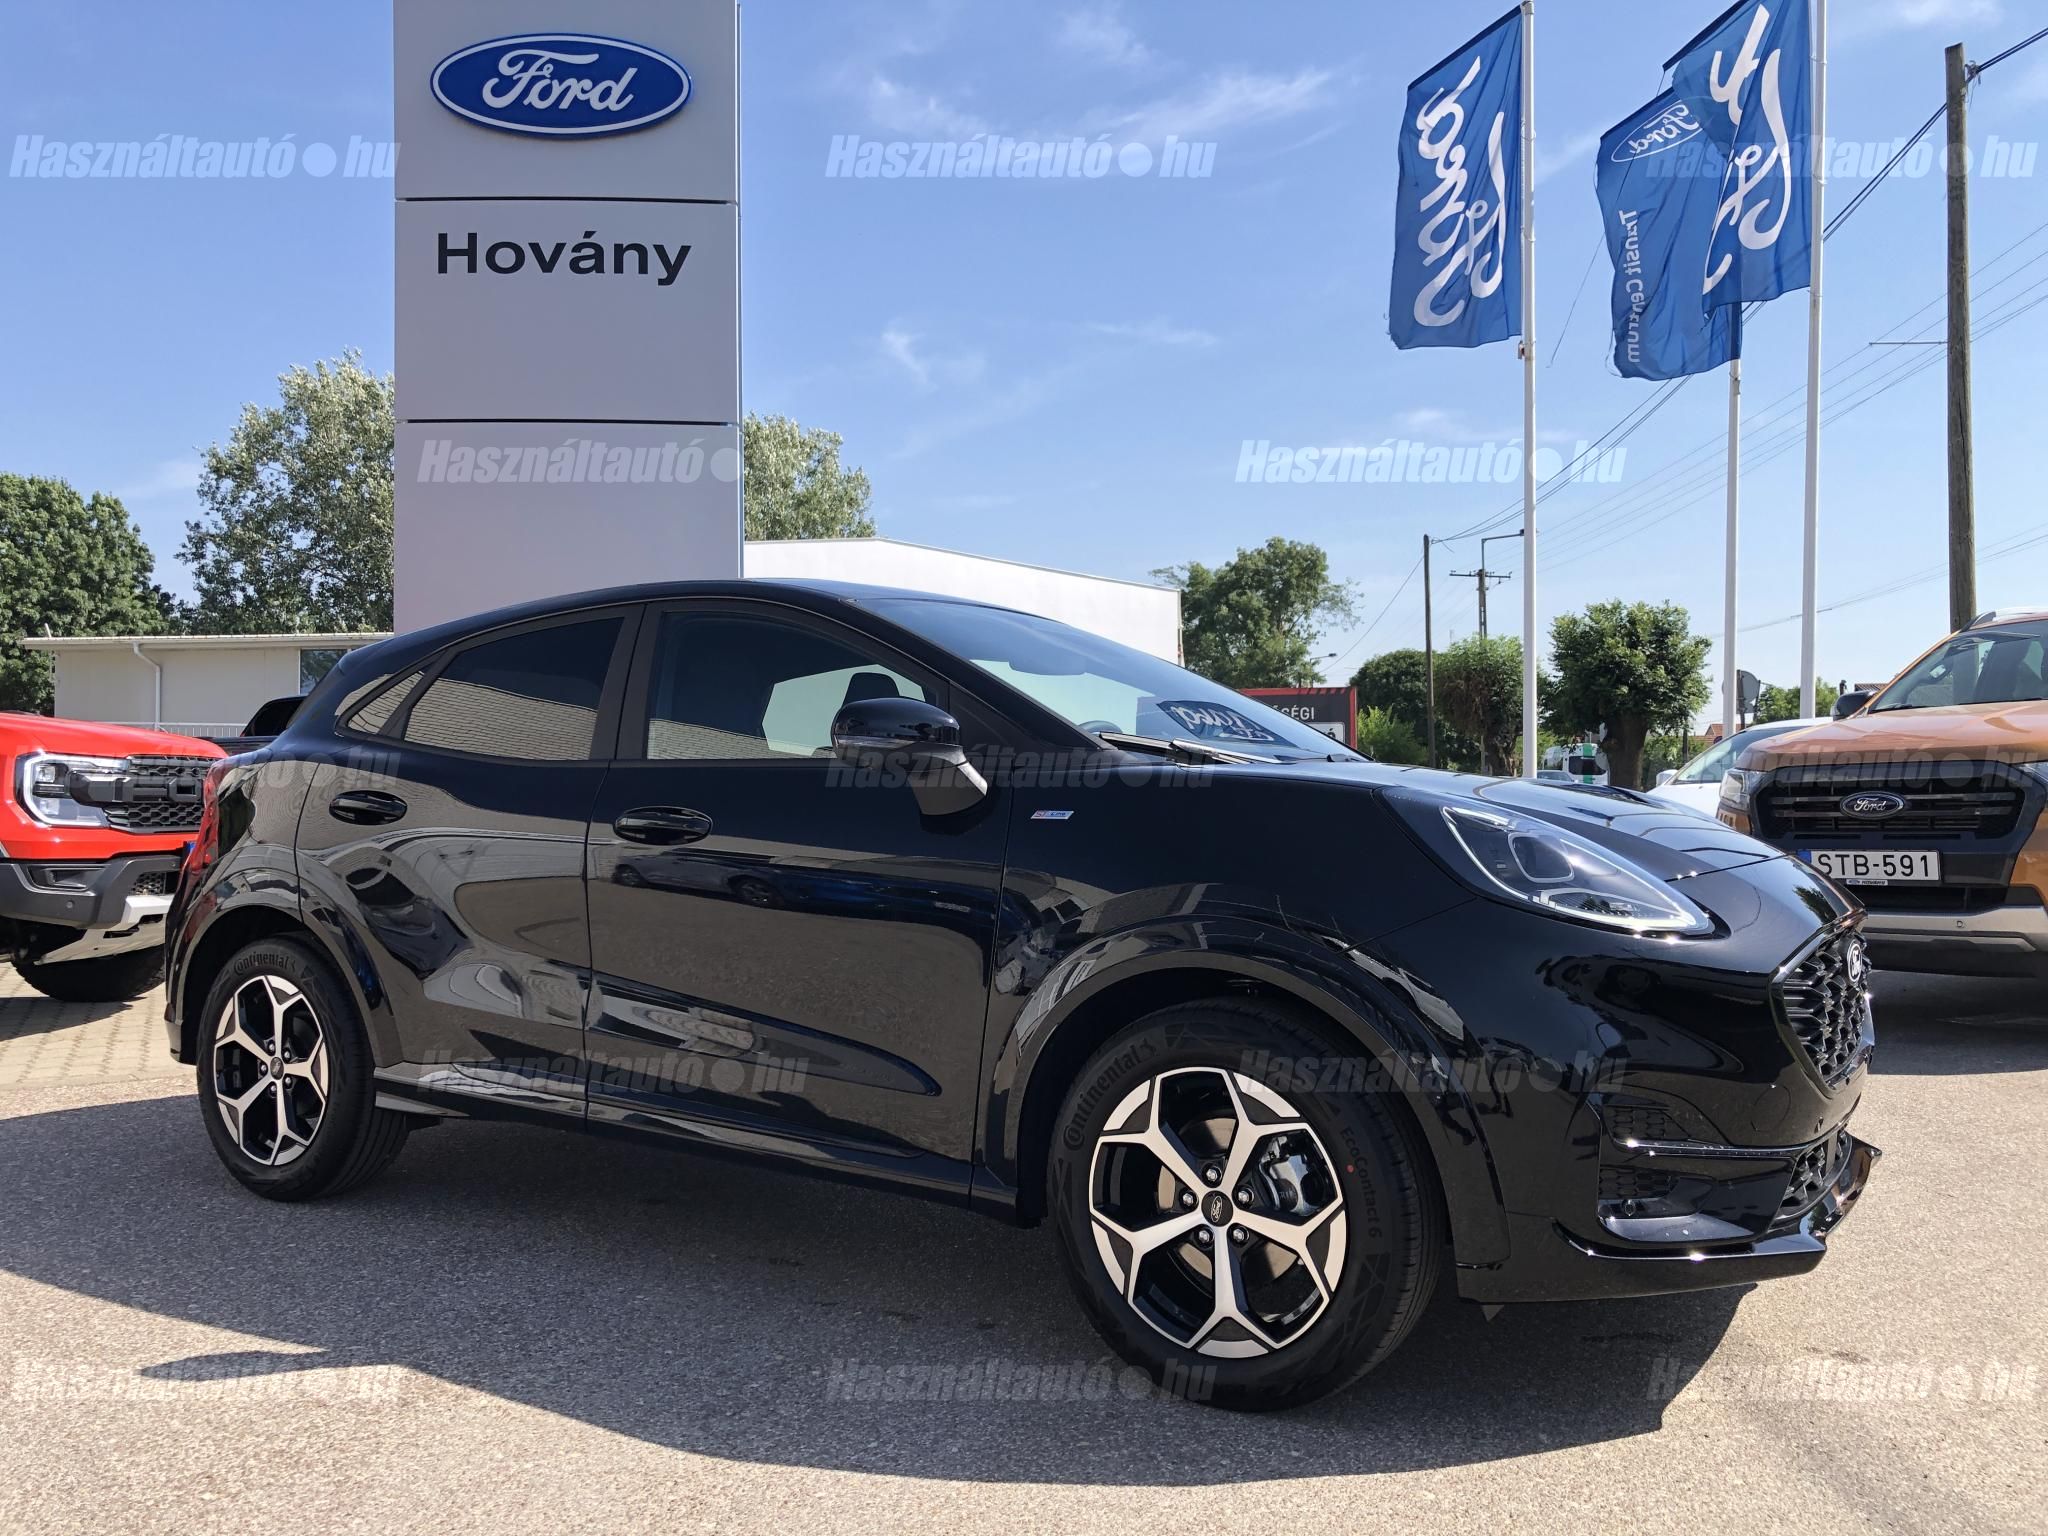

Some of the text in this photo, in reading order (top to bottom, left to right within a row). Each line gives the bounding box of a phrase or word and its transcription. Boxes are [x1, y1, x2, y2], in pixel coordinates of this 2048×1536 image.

[481, 49, 638, 112] Ford
[437, 231, 692, 287] Hovány
[1853, 798, 1887, 812] Ford
[1817, 854, 1929, 877] STB-591
[233, 951, 289, 976] Continental
[1063, 1045, 1142, 1151] Continental
[1339, 1126, 1384, 1239] EcoContact 6
